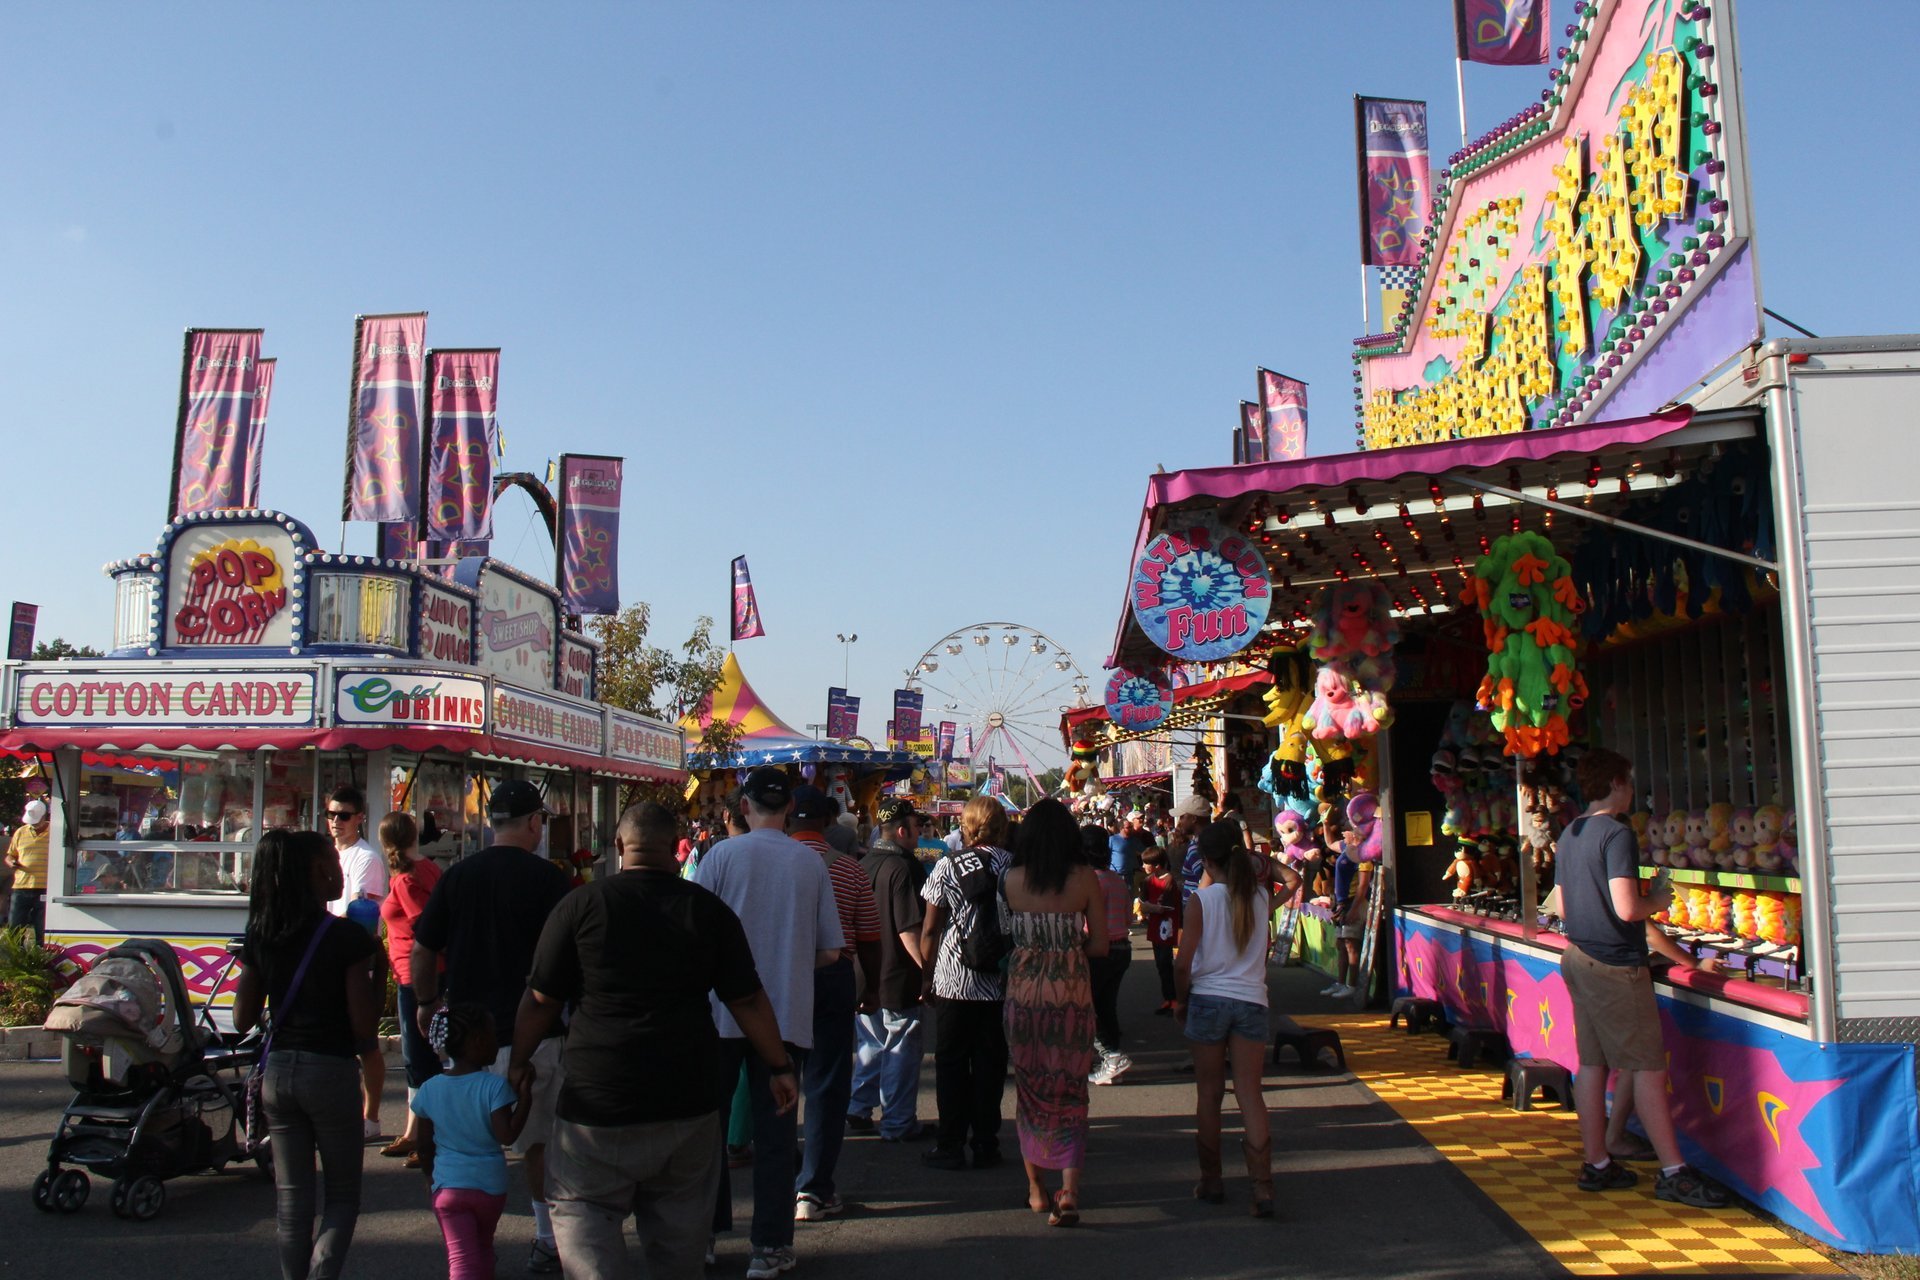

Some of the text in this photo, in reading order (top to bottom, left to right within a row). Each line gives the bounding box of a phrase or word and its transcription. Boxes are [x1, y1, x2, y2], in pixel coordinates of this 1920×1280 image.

[193, 548, 275, 597] POP
[1135, 527, 1268, 611] WATER GUN
[174, 586, 287, 637] CORN
[494, 619, 539, 643] SWEET SHOP
[1164, 603, 1249, 650] Fun
[30, 681, 301, 717] COTTON CANDY
[392, 693, 483, 725] DRINKS
[1120, 703, 1162, 726] Fun
[498, 693, 600, 749] COTTON CANDY
[613, 723, 681, 763] POPCORN
